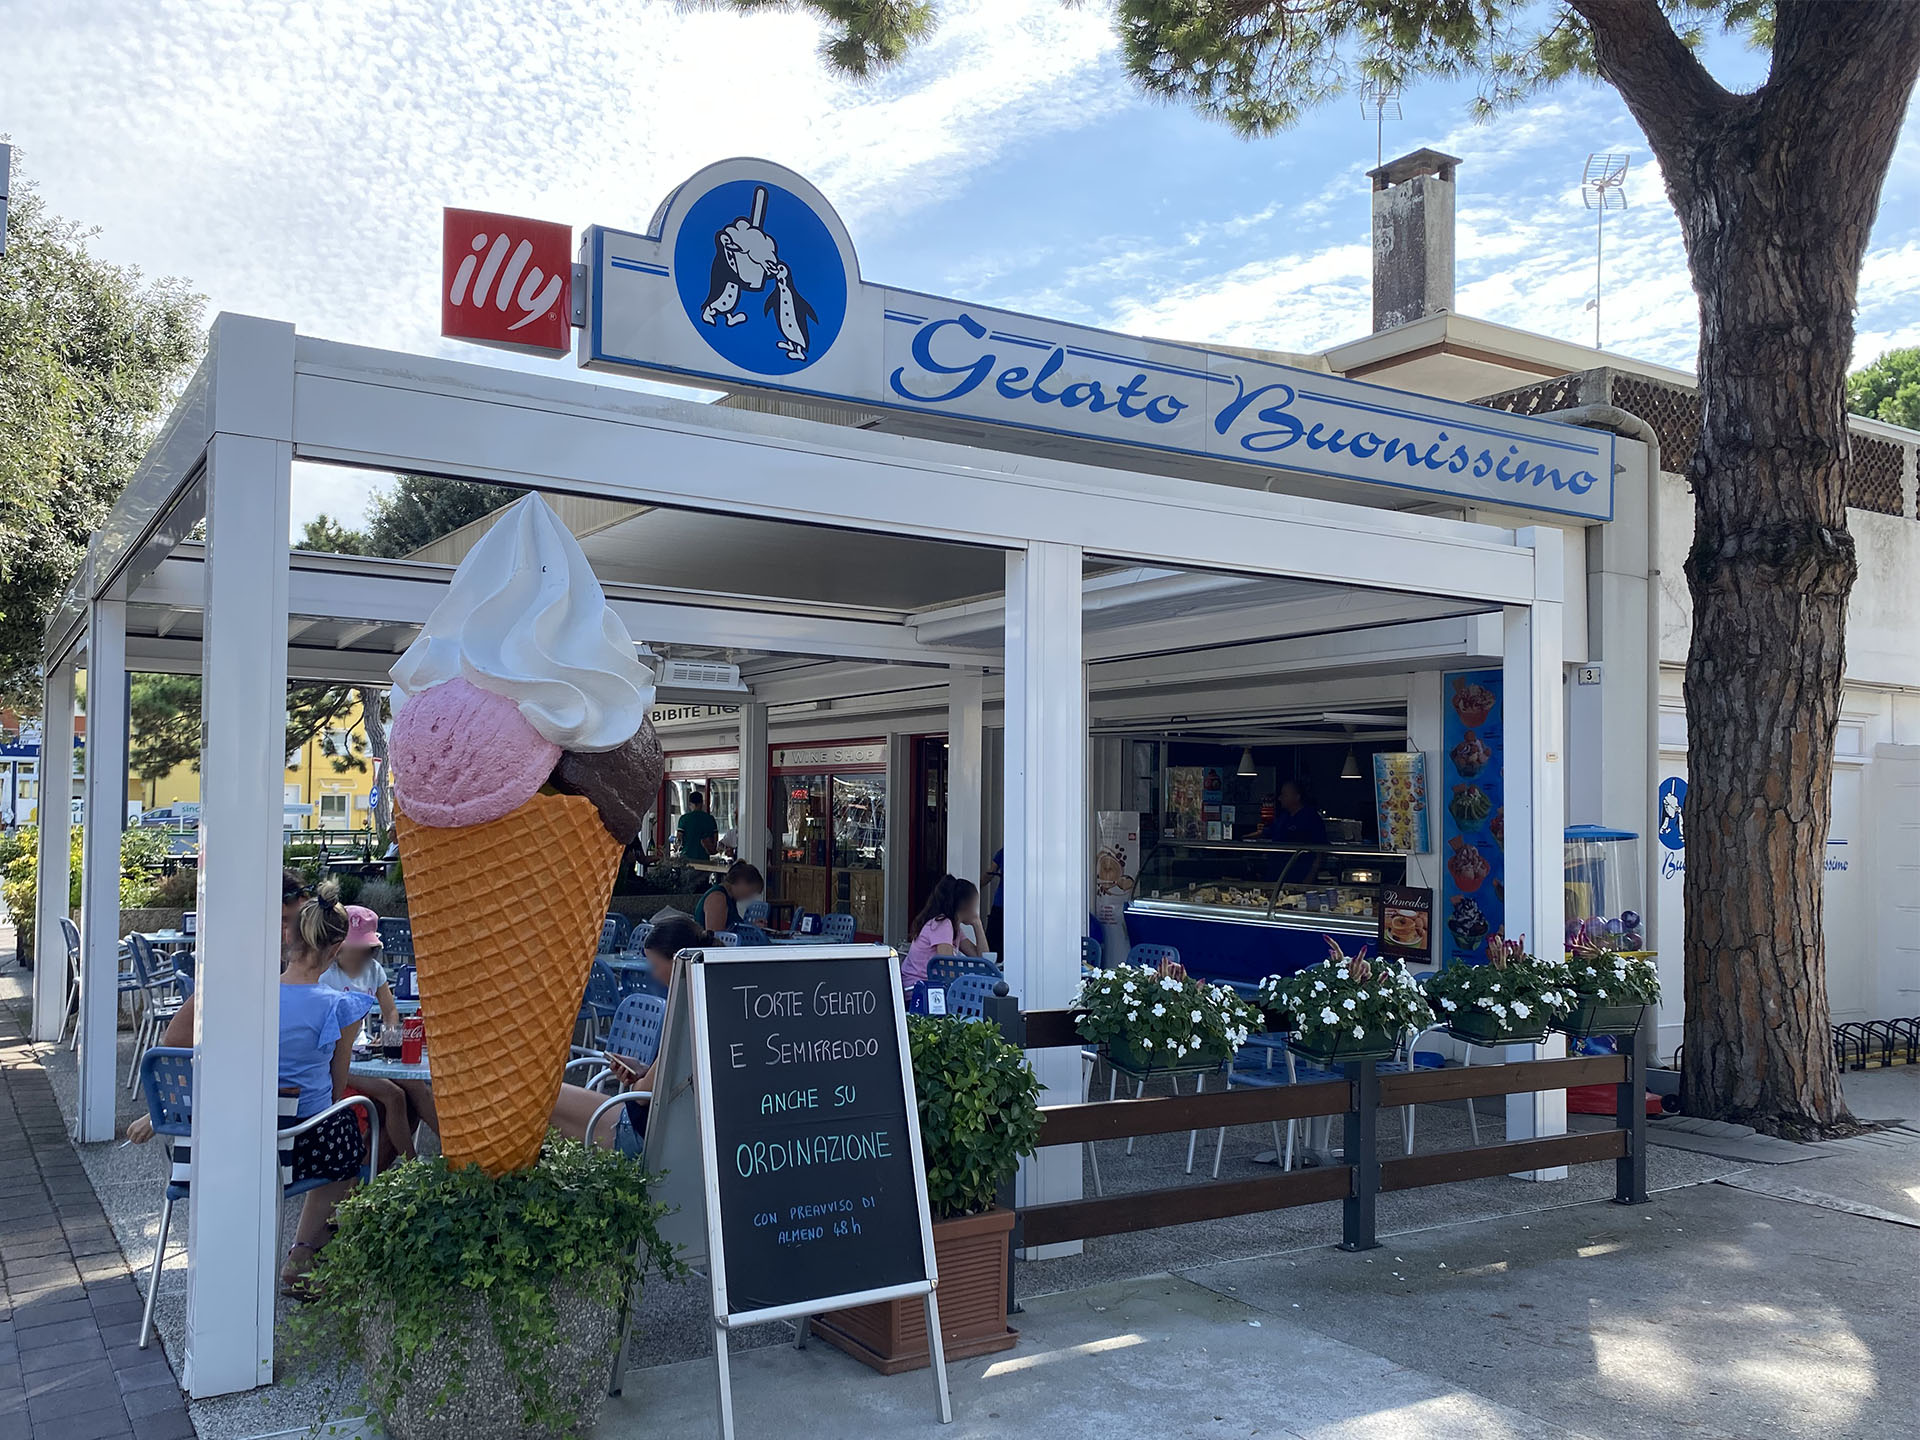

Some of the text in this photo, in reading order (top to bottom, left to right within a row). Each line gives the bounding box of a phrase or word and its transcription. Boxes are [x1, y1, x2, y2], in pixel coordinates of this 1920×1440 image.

[450, 232, 562, 331] illy
[889, 313, 1599, 496] Gelato Buonissimo
[1586, 670, 1593, 681] 3
[652, 706, 700, 722] BIBITE
[1383, 890, 1429, 909] Pancakes
[732, 981, 877, 1020] TORTE GELATO
[730, 1033, 879, 1069] E SEMIFREDDO
[761, 1085, 856, 1115] ANCHE SU
[736, 1131, 892, 1178] ORDINAZIONE
[753, 1195, 876, 1228] CON PREAVVISO DI
[777, 1225, 824, 1245] ALMENO
